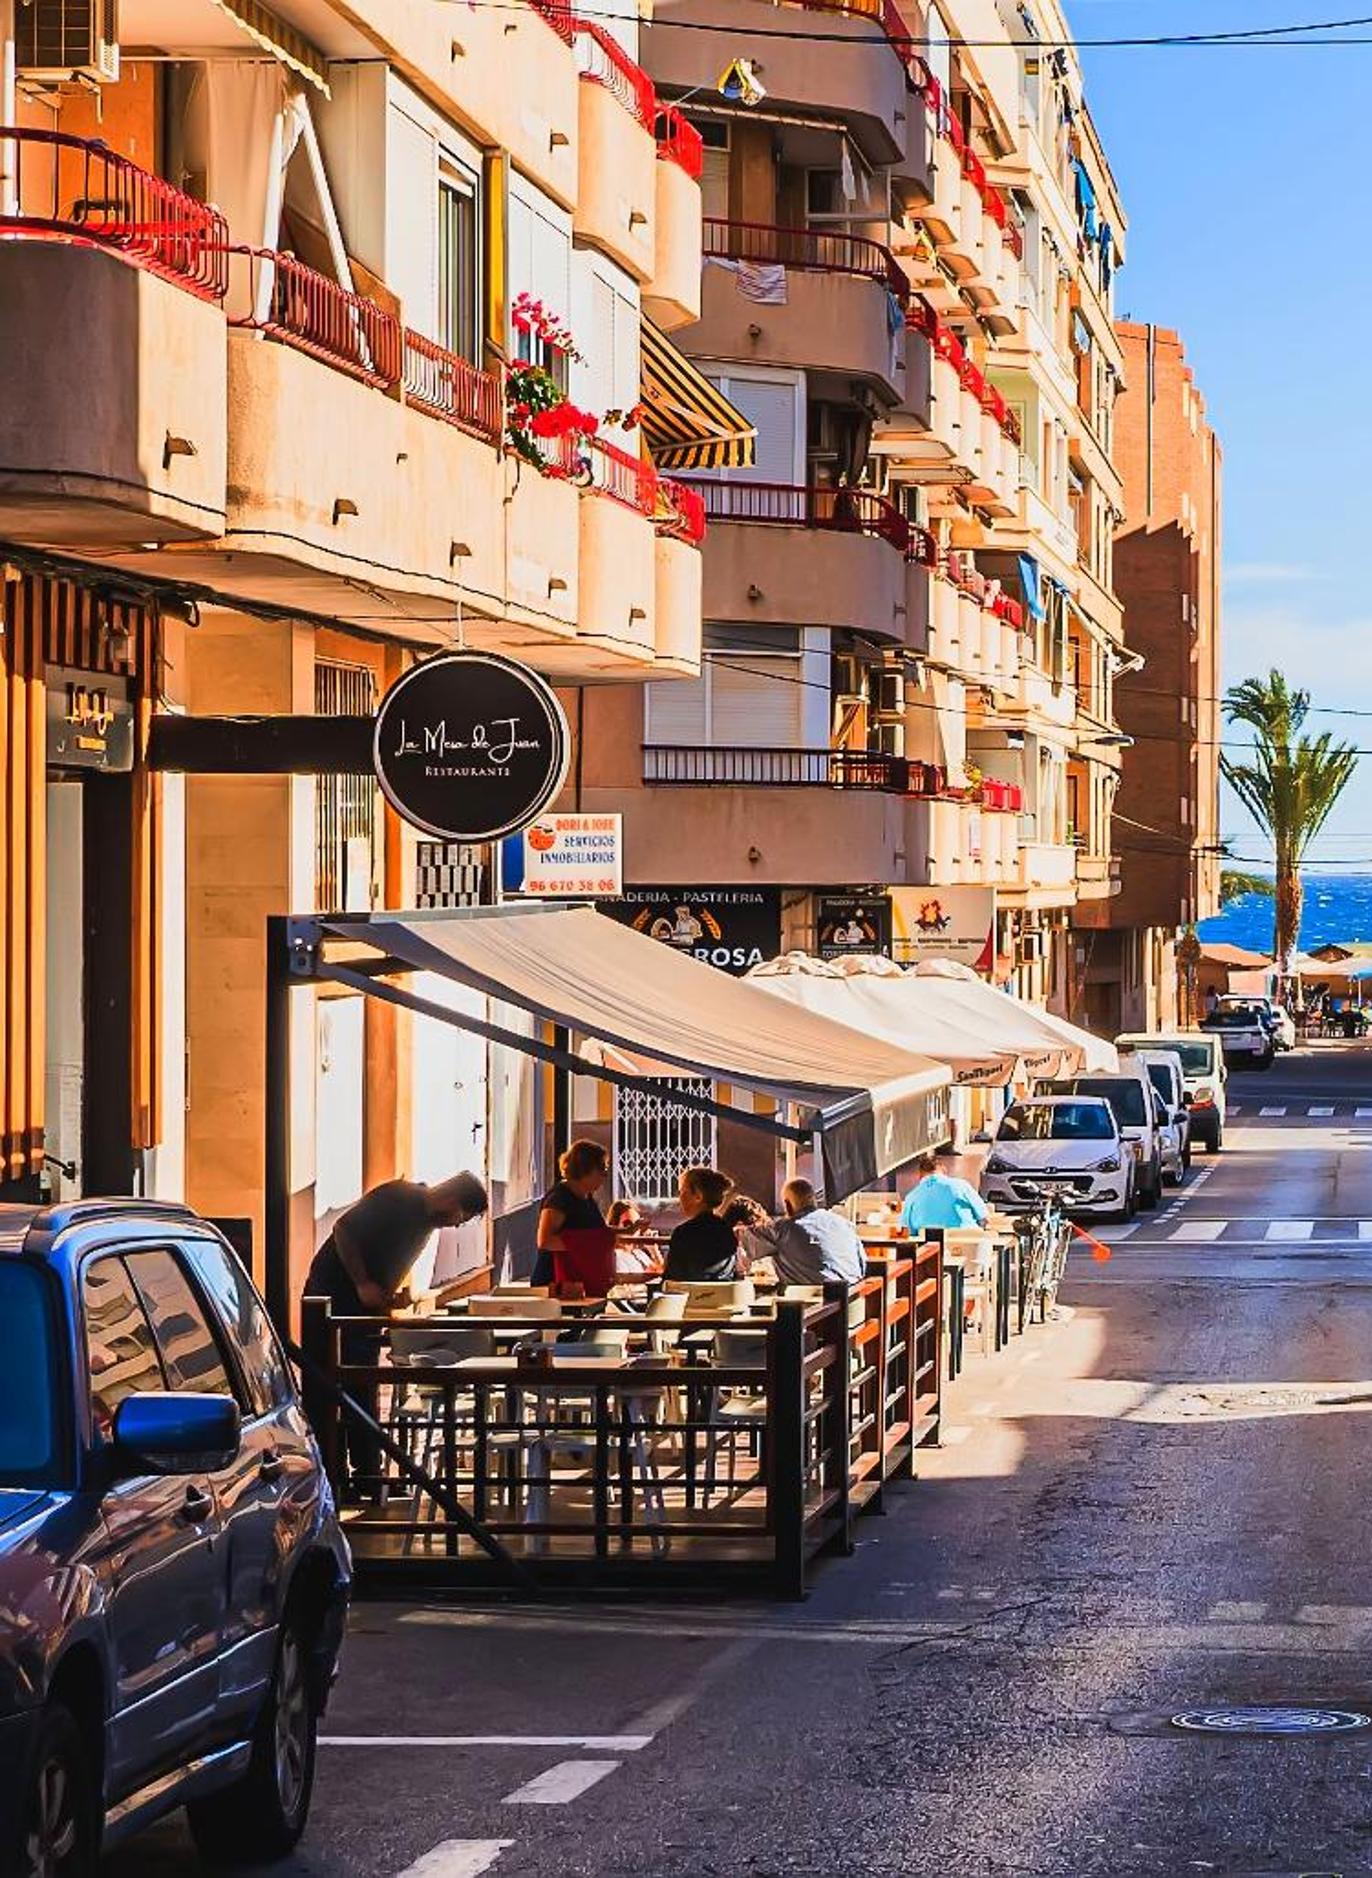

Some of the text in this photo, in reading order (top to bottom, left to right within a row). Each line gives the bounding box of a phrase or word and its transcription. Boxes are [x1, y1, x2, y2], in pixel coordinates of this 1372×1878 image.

[471, 724, 491, 749] de
[488, 717, 540, 764] Juan
[564, 835, 616, 847] SERVICIOS
[540, 851, 616, 864] INMOBILIARIOS
[529, 881, 547, 892] 96
[550, 881, 574, 891] 670
[598, 879, 616, 891] 06
[683, 892, 764, 904] PASTELERIA
